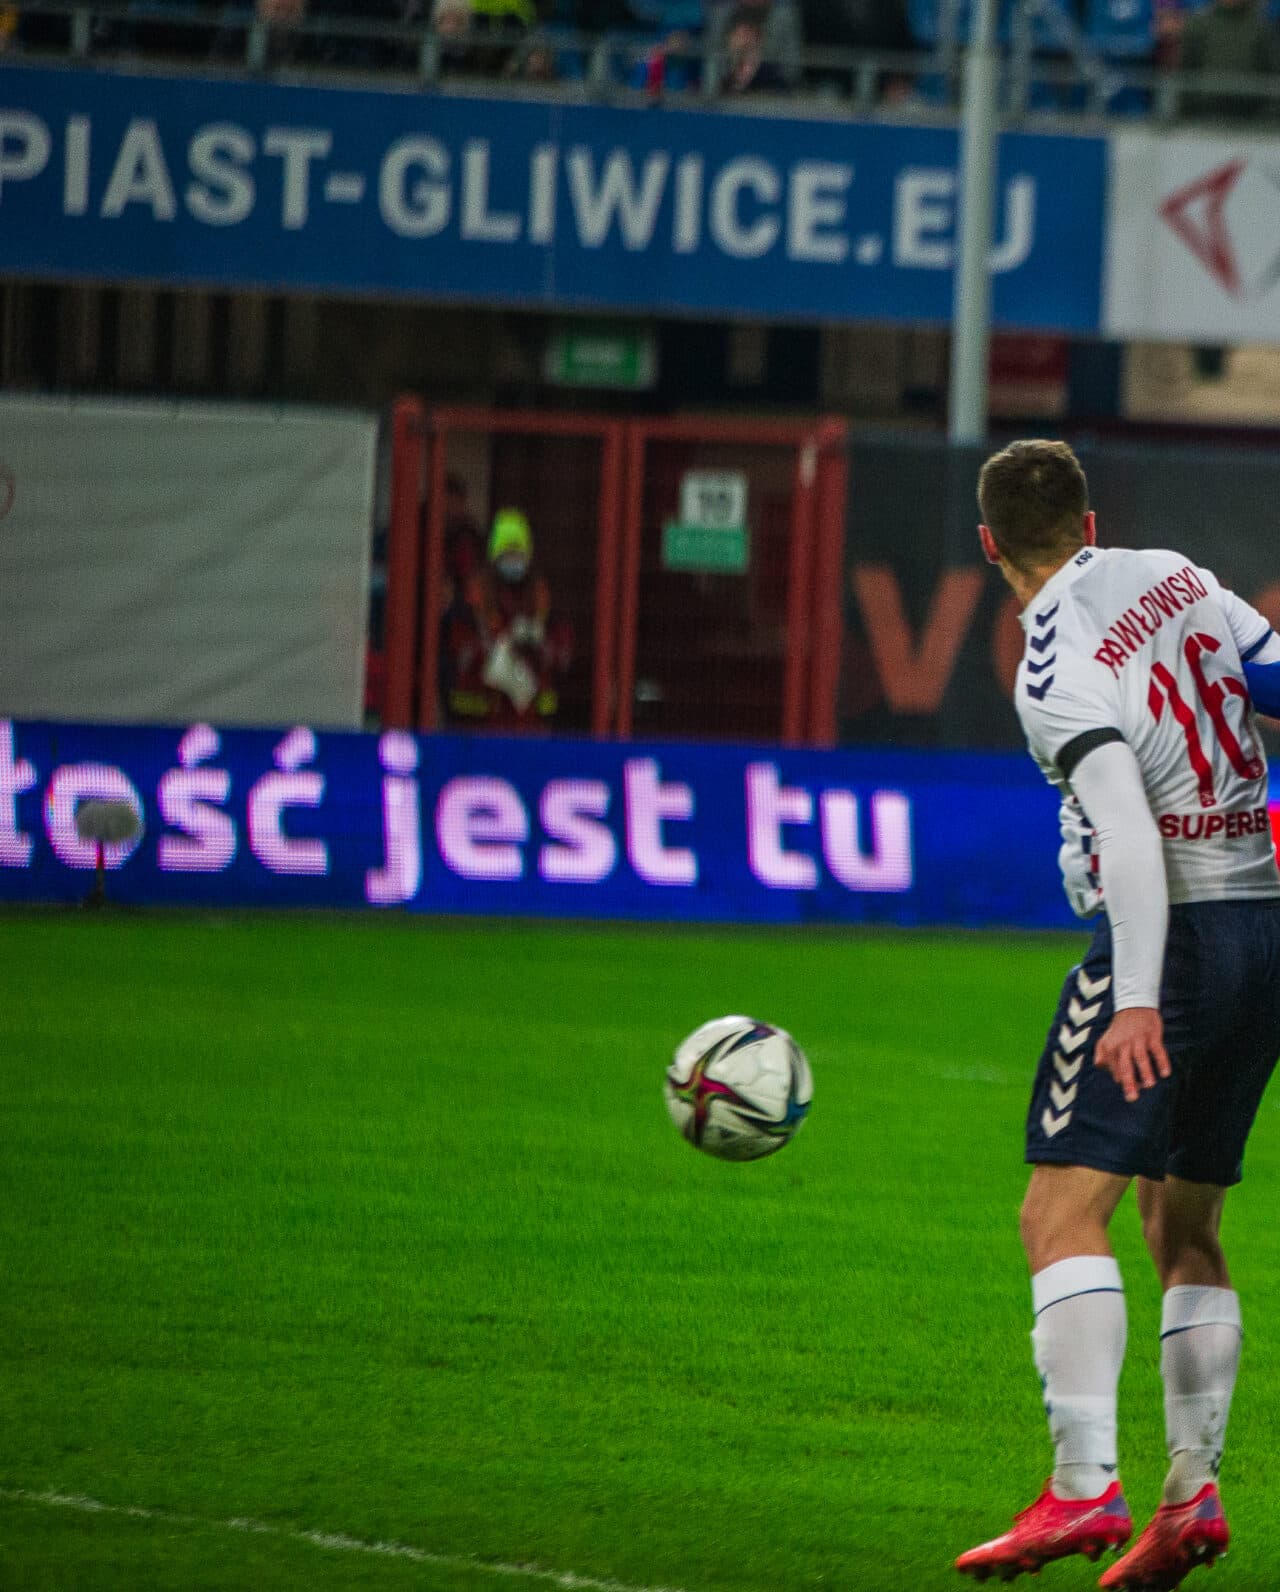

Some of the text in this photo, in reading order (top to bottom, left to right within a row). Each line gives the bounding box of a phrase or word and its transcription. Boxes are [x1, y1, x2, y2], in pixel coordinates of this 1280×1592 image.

[1093, 565, 1210, 681] PAWŁOWSKI
[1147, 631, 1265, 809] 16
[365, 728, 698, 906] jest
[745, 759, 913, 892] tu
